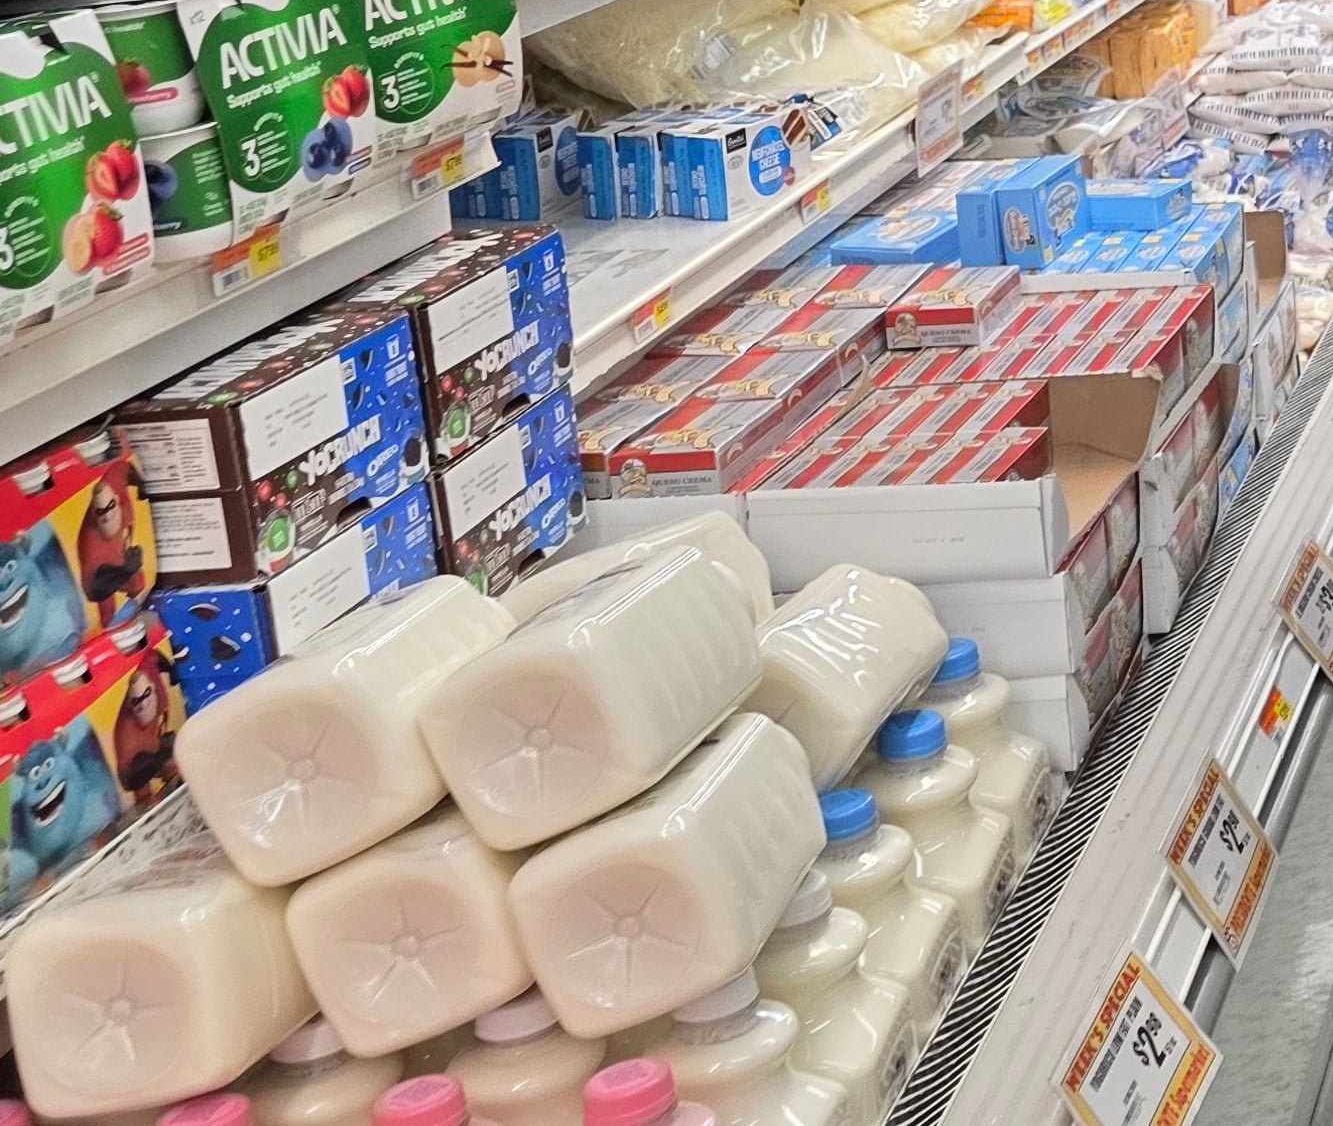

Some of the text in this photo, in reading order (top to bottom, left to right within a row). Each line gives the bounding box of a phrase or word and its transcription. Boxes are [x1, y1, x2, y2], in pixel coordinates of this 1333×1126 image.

[368, 25, 415, 50] Supports
[227, 82, 273, 110] Supports
[298, 413, 383, 486] YoCRUNCH
[1099, 962, 1140, 1030] SPECIAL
